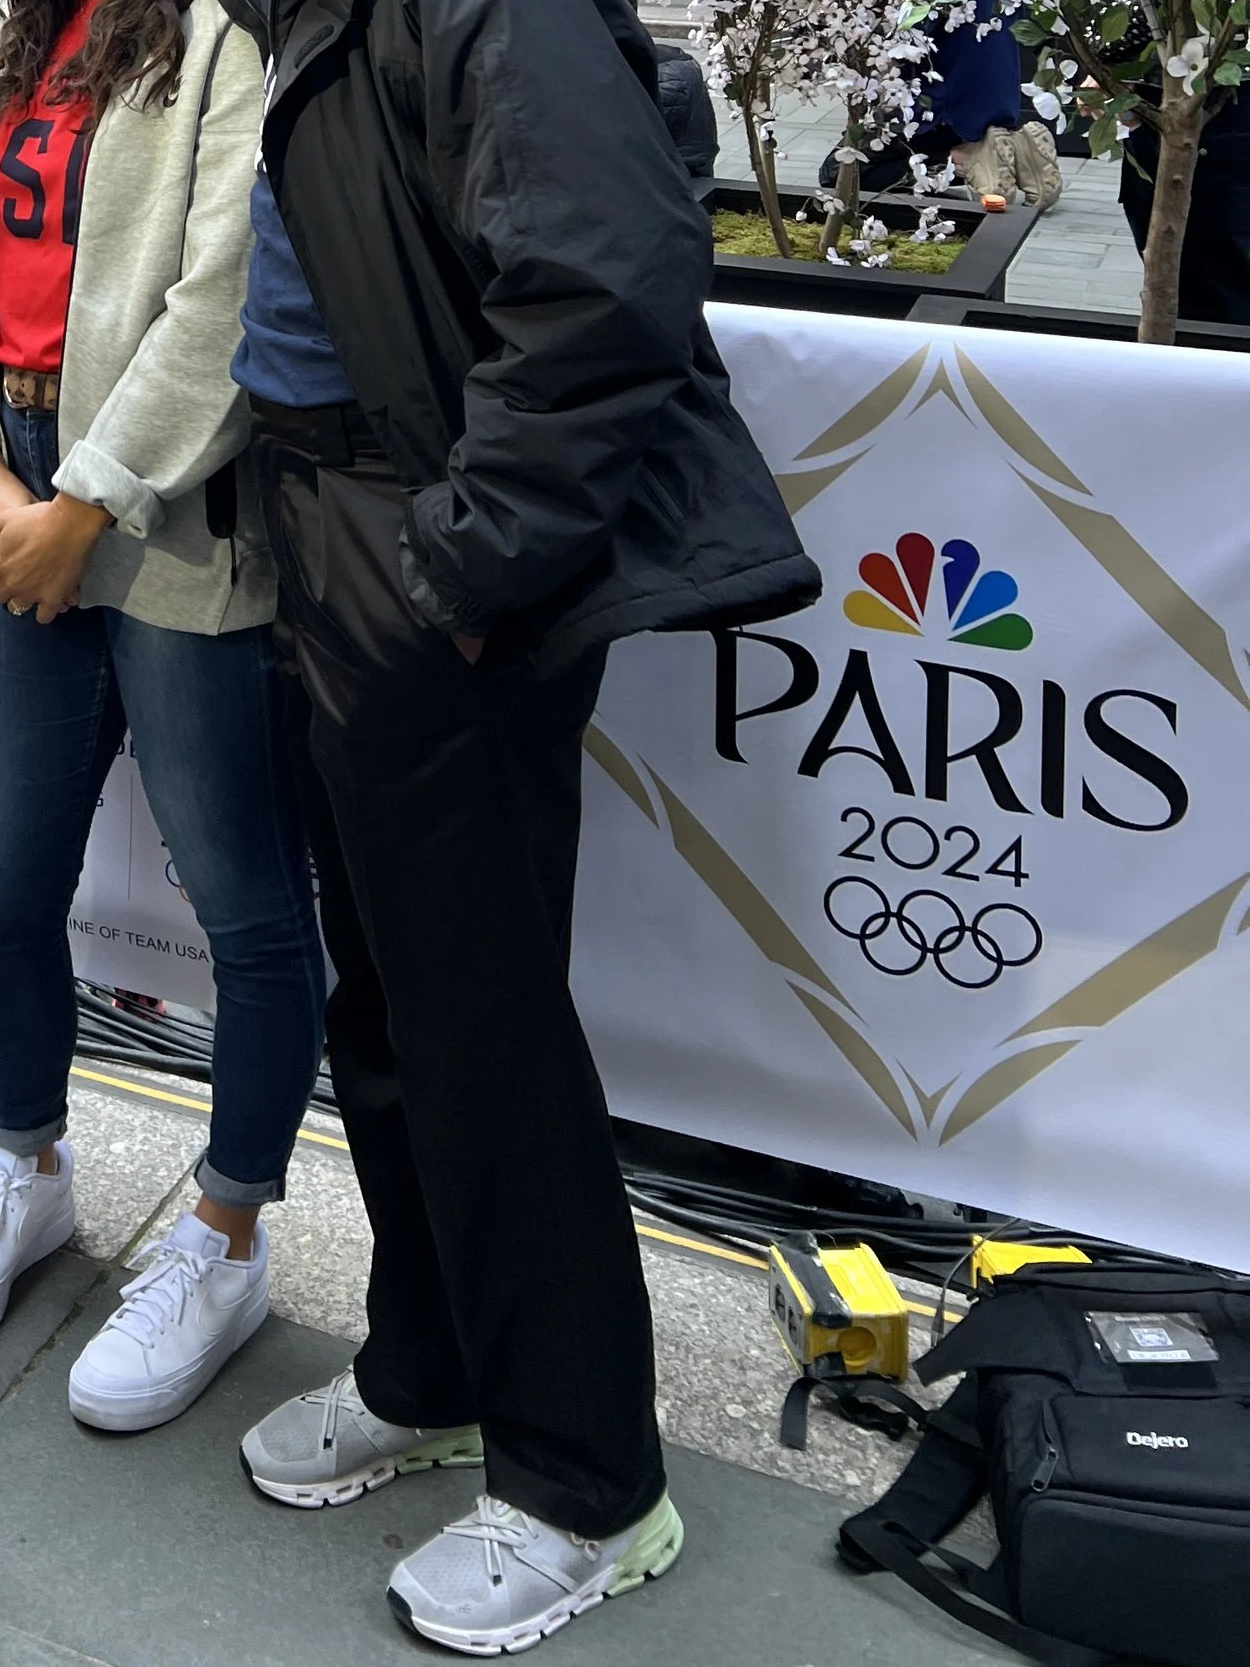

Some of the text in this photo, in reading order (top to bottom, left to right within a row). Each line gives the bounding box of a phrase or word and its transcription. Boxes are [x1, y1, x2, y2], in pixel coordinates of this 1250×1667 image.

[709, 628, 1190, 833] PARIS
[837, 806, 1030, 888] 2024
[99, 925, 121, 941] OF
[125, 931, 172, 954] TEAM
[175, 942, 210, 963] USA
[1126, 1431, 1189, 1450] Dejero
